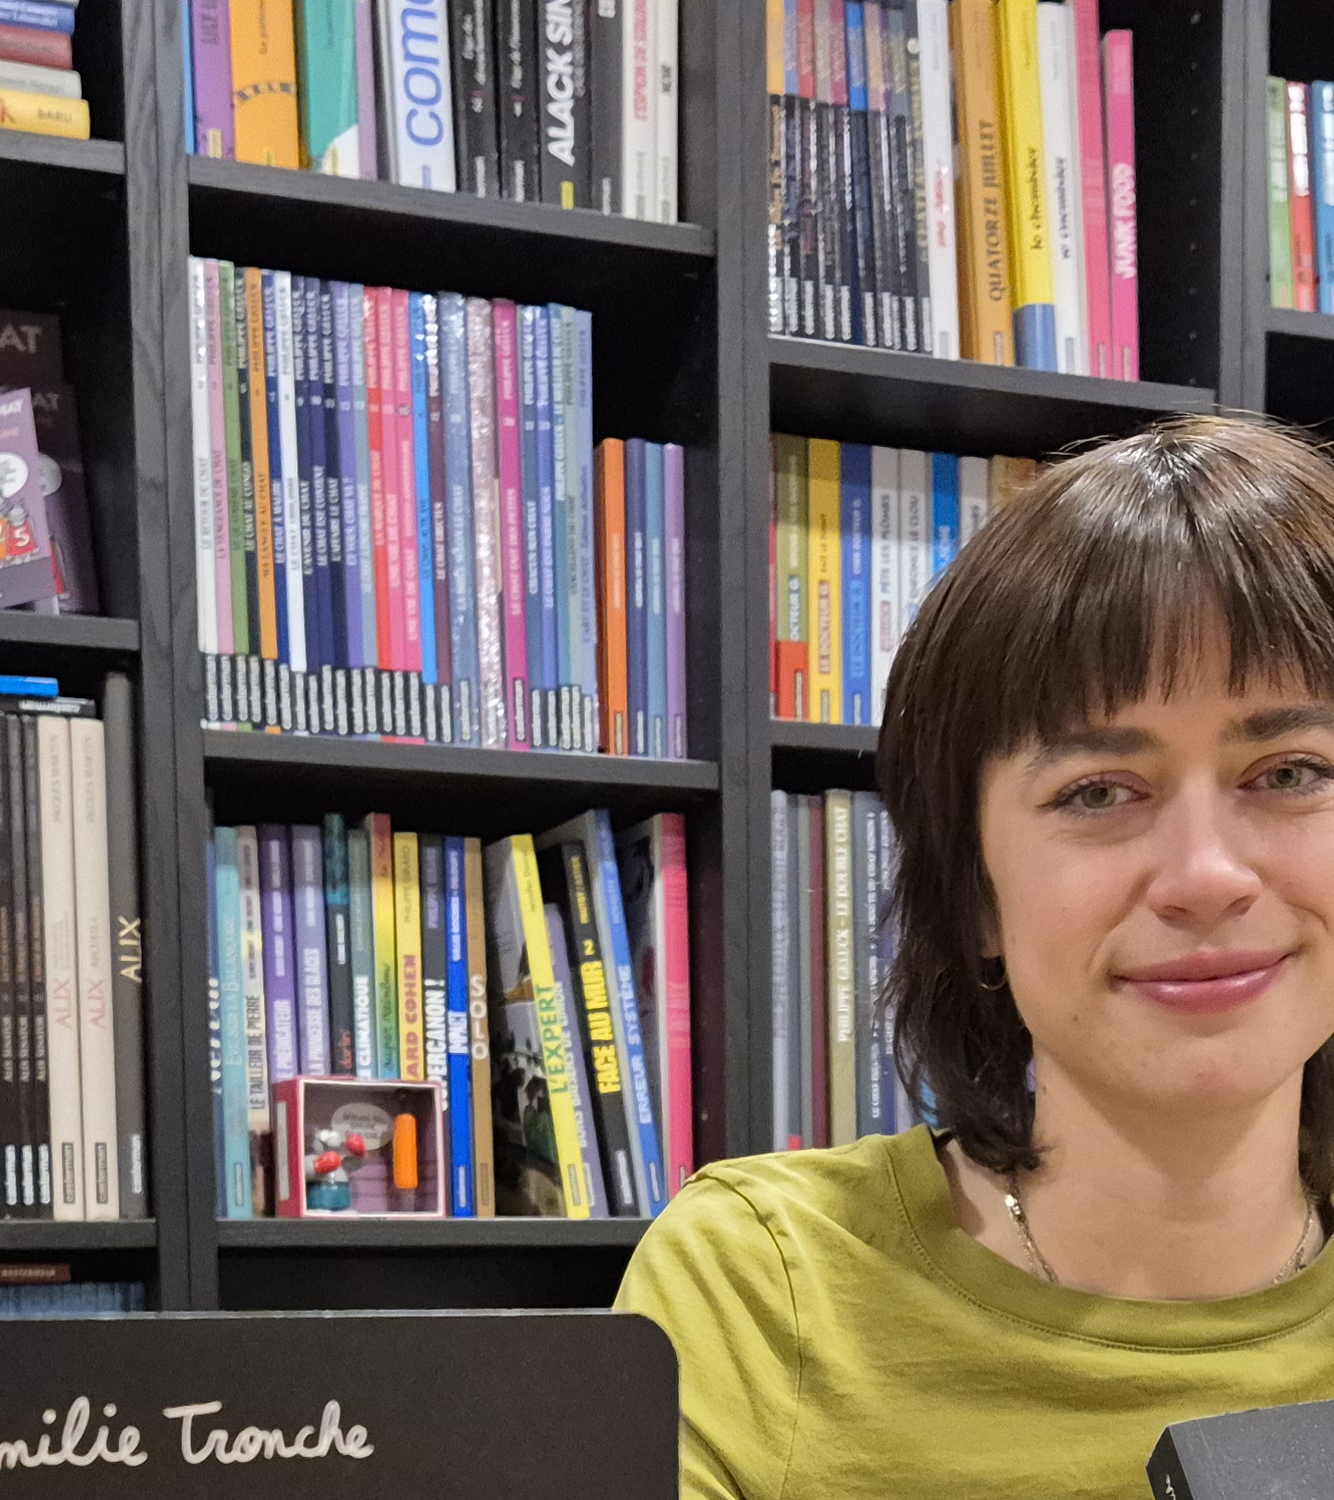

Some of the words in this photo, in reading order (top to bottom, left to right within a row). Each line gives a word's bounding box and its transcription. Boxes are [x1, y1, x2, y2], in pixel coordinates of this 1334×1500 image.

[401, 0, 445, 147] com
[546, 48, 576, 167] ALACK
[119, 915, 143, 984] ALIX
[583, 939, 595, 956] 2
[245, 994, 262, 1031] PIERRE
[404, 954, 419, 1025] COHEN
[469, 974, 488, 1060] SOLO
[581, 961, 608, 1010] MUR
[616, 964, 641, 1046] SYSTÈME
[247, 1033, 264, 1046] DE
[353, 975, 371, 1067] CLIMATIQUE
[447, 1010, 468, 1055] IMPACT
[534, 983, 569, 1095] L'EXPERT
[588, 1011, 614, 1042] AU
[248, 1049, 266, 1096] TAILLEUR
[595, 1044, 621, 1094] FACE
[630, 1055, 653, 1125] ERREUR
[250, 1098, 267, 1111] LE
[163, 1400, 375, 1465] Tronche
